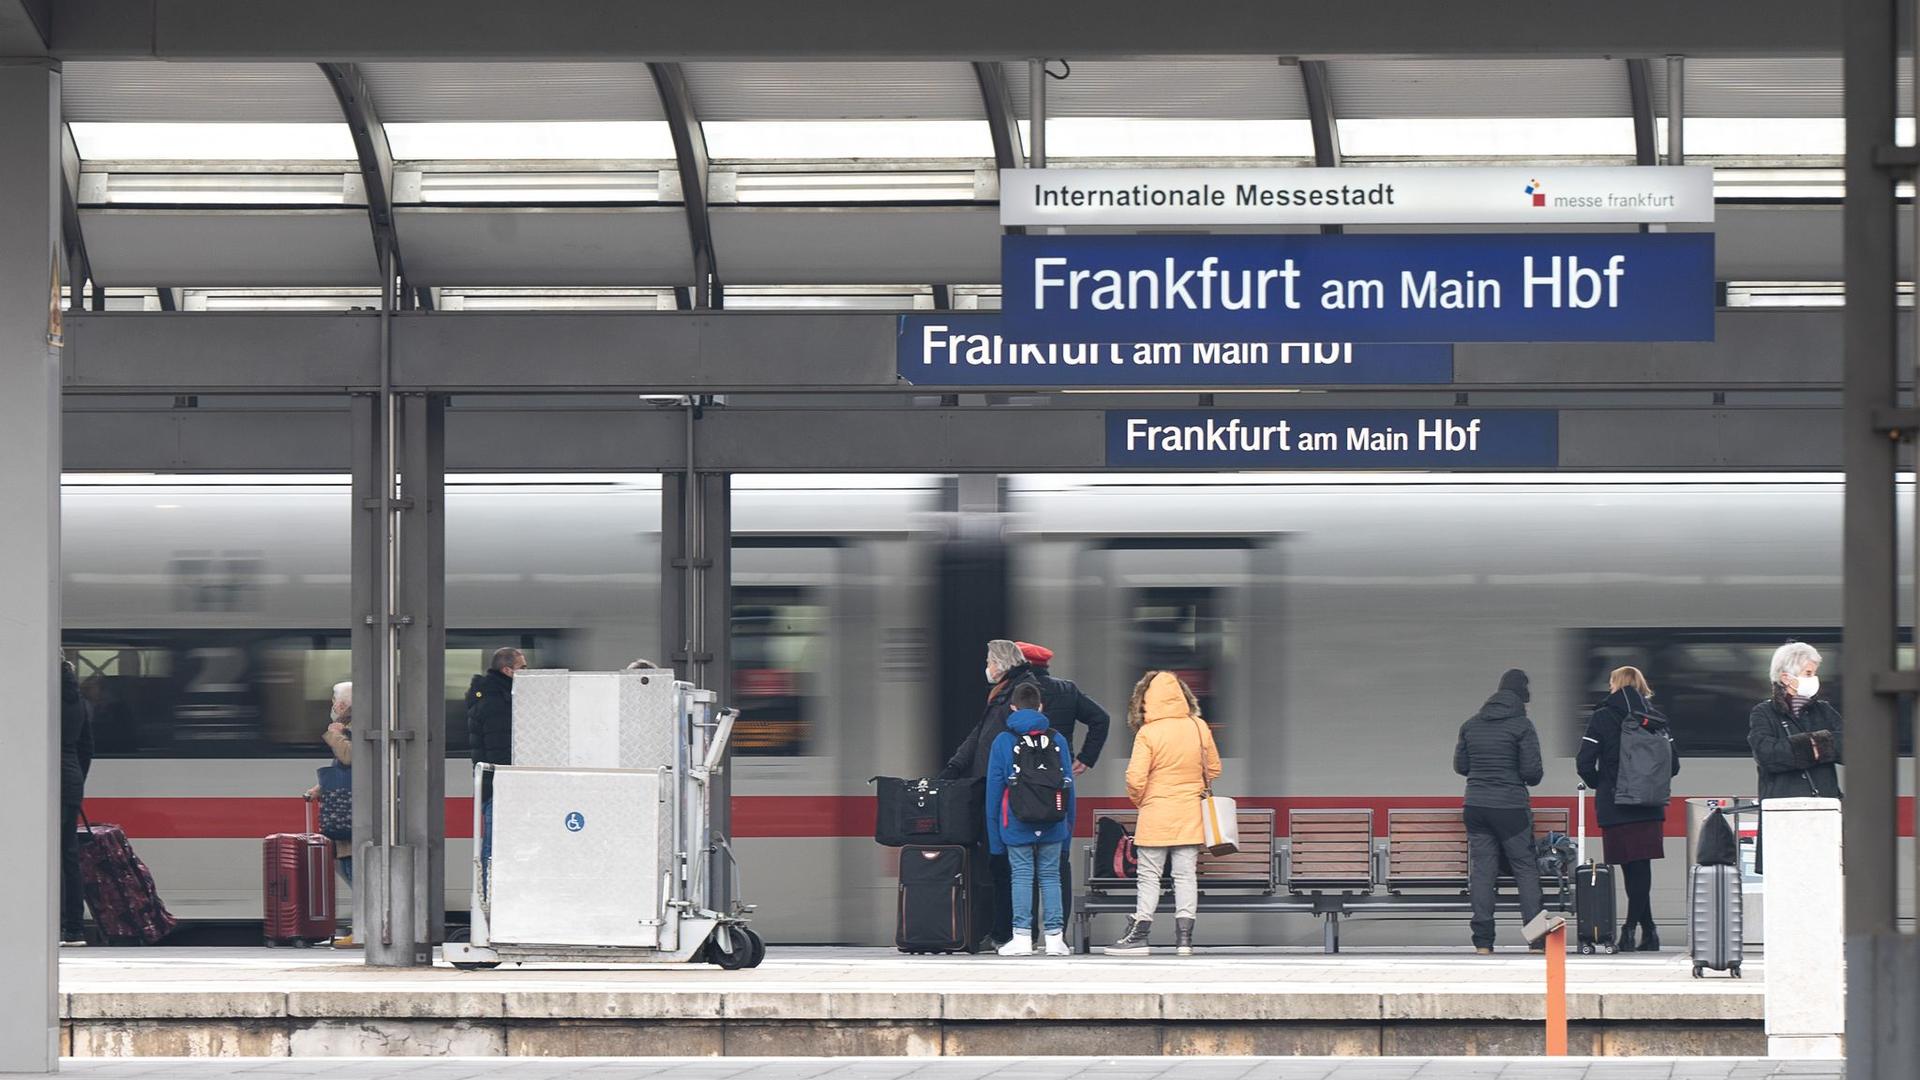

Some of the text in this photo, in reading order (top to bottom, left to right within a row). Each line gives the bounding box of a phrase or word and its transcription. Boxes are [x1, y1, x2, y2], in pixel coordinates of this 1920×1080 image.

[1035, 183, 1395, 207] Internationale Messestadt
[1554, 193, 1675, 208] messe frankfurt
[1034, 254, 1625, 311] Frankfurt am Main Hbf
[1132, 343, 1181, 365] am
[1192, 343, 1269, 365] Main
[1126, 418, 1481, 452] Frankfurt am Main Hbf
